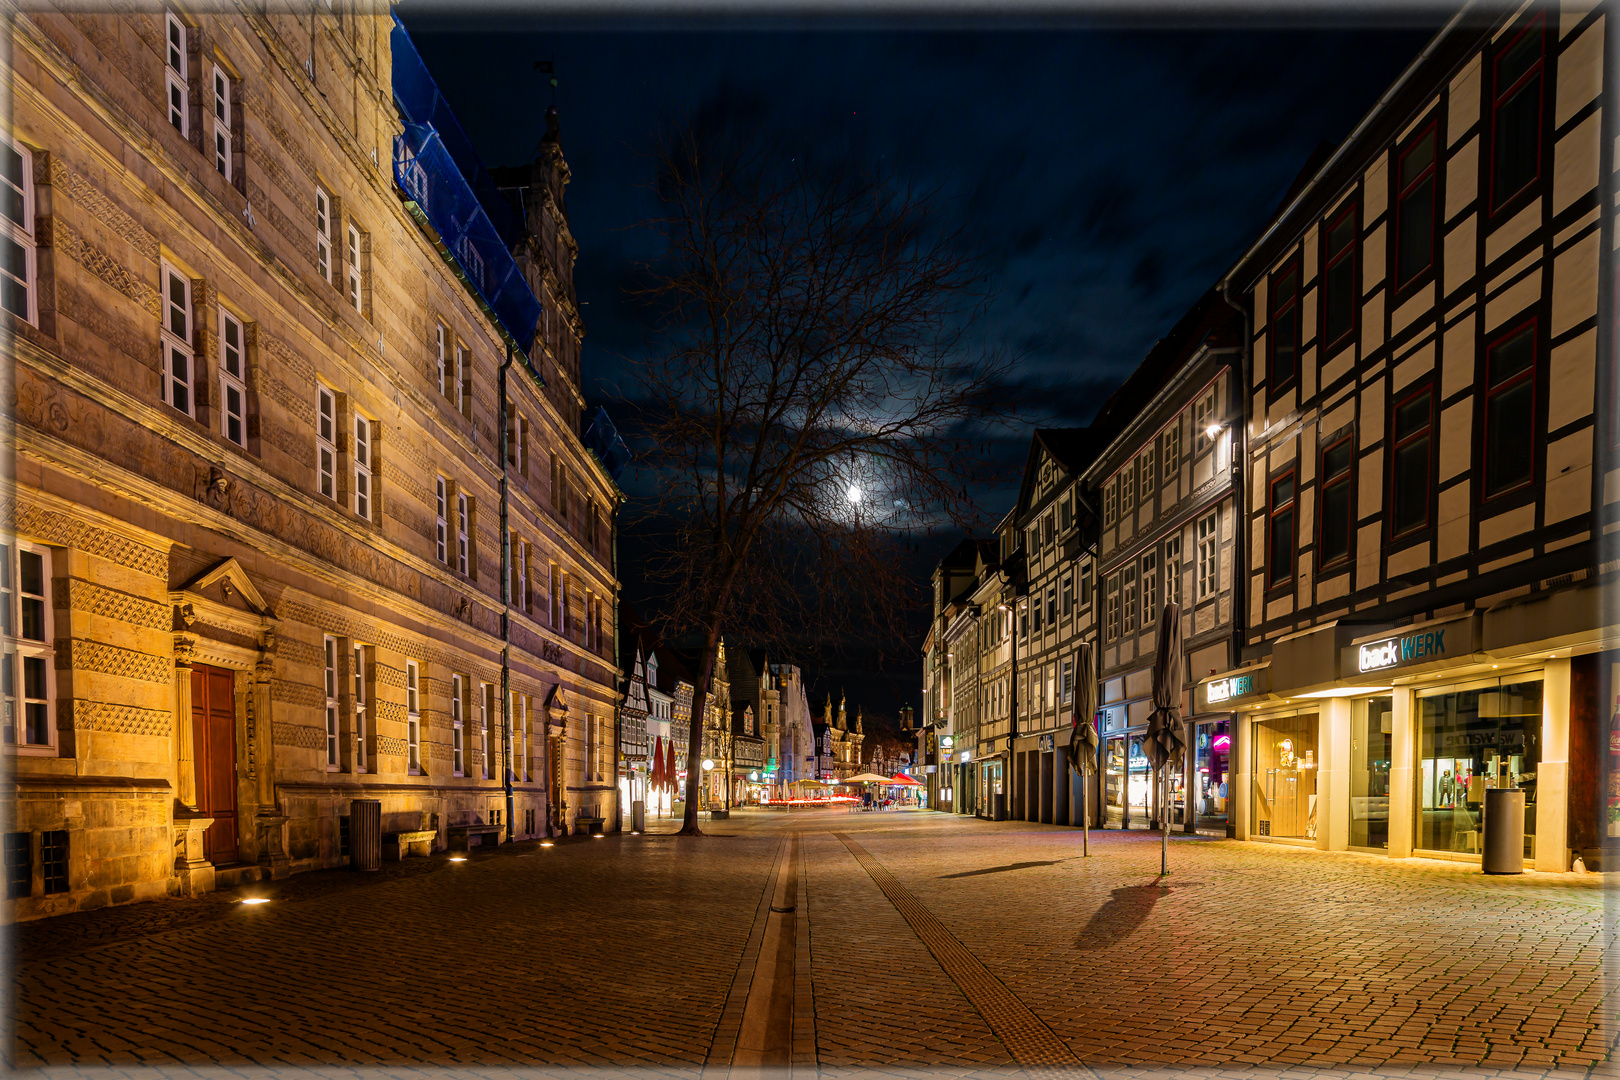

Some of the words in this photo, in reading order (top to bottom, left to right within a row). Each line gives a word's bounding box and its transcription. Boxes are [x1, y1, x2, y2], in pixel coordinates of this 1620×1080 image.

[1361, 641, 1398, 669] back
[1401, 629, 1445, 661] WERK
[1208, 680, 1230, 701] back
[1229, 674, 1254, 697] WERK
